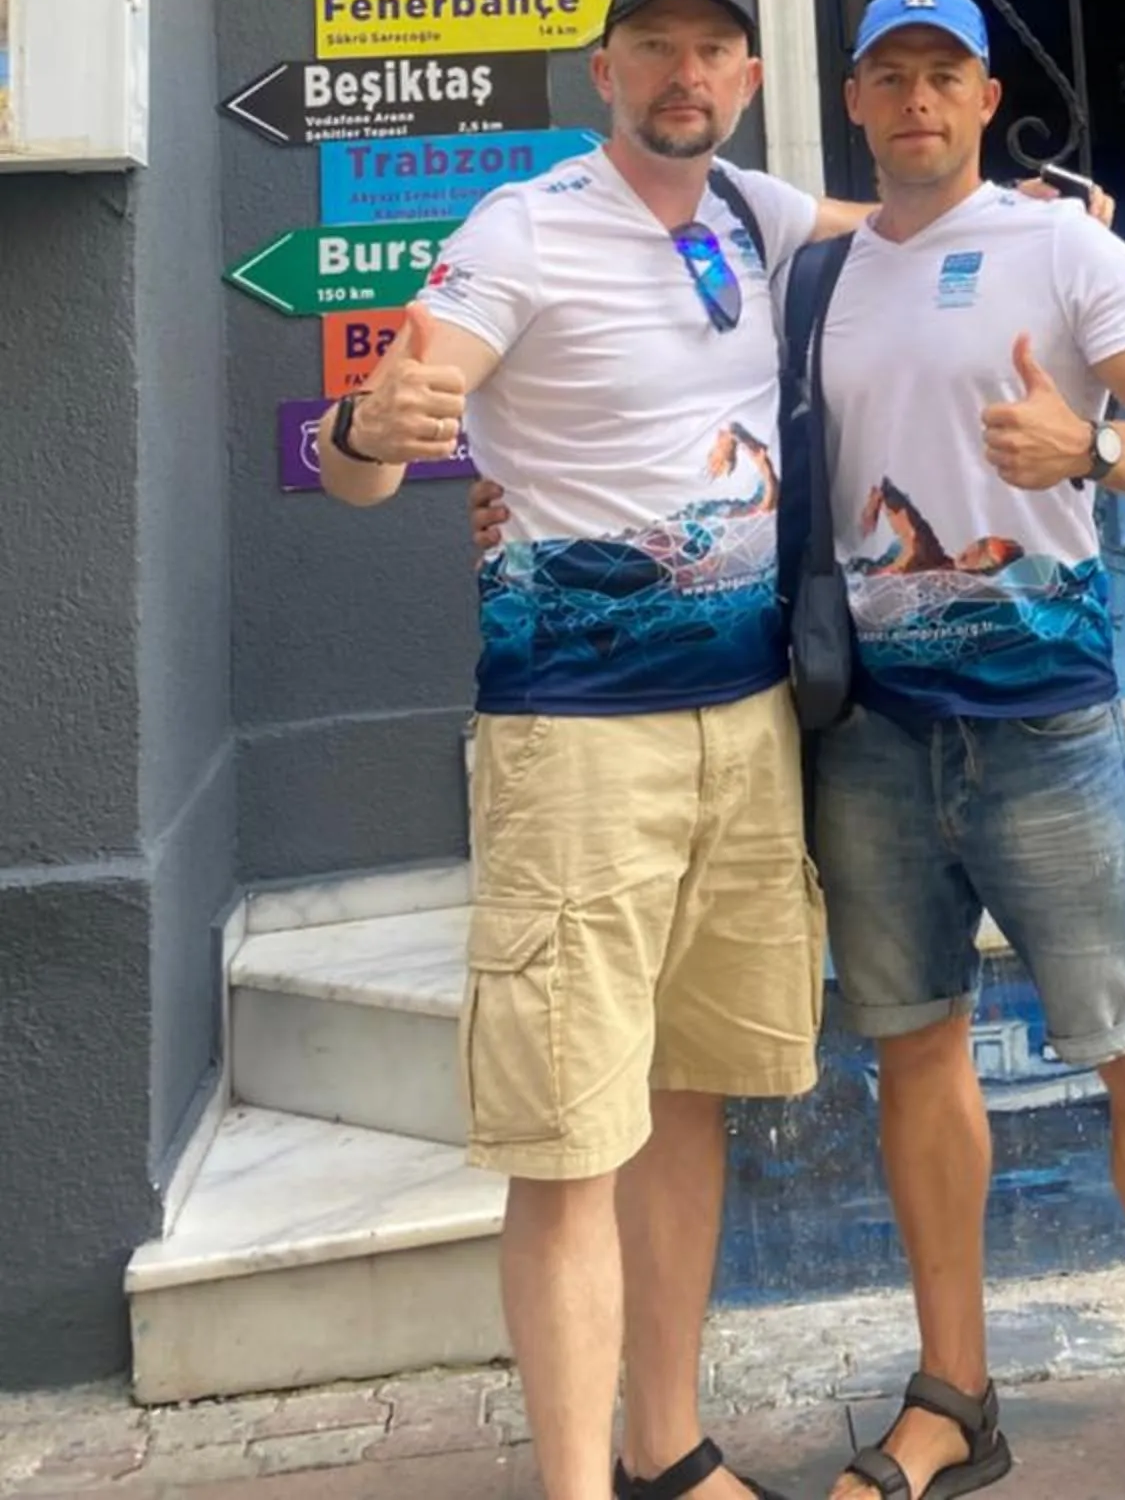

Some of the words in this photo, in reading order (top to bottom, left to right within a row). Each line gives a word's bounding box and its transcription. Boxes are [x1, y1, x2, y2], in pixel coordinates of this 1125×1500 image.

[557, 25, 577, 36] km
[304, 61, 492, 111] Beşiktaş
[305, 114, 370, 127] Vodafone
[374, 112, 415, 123] Arena
[482, 119, 503, 131] km
[363, 124, 408, 138] Tepesi
[346, 143, 534, 179] Trabzon
[317, 289, 344, 302] 150
[351, 286, 375, 300] km
